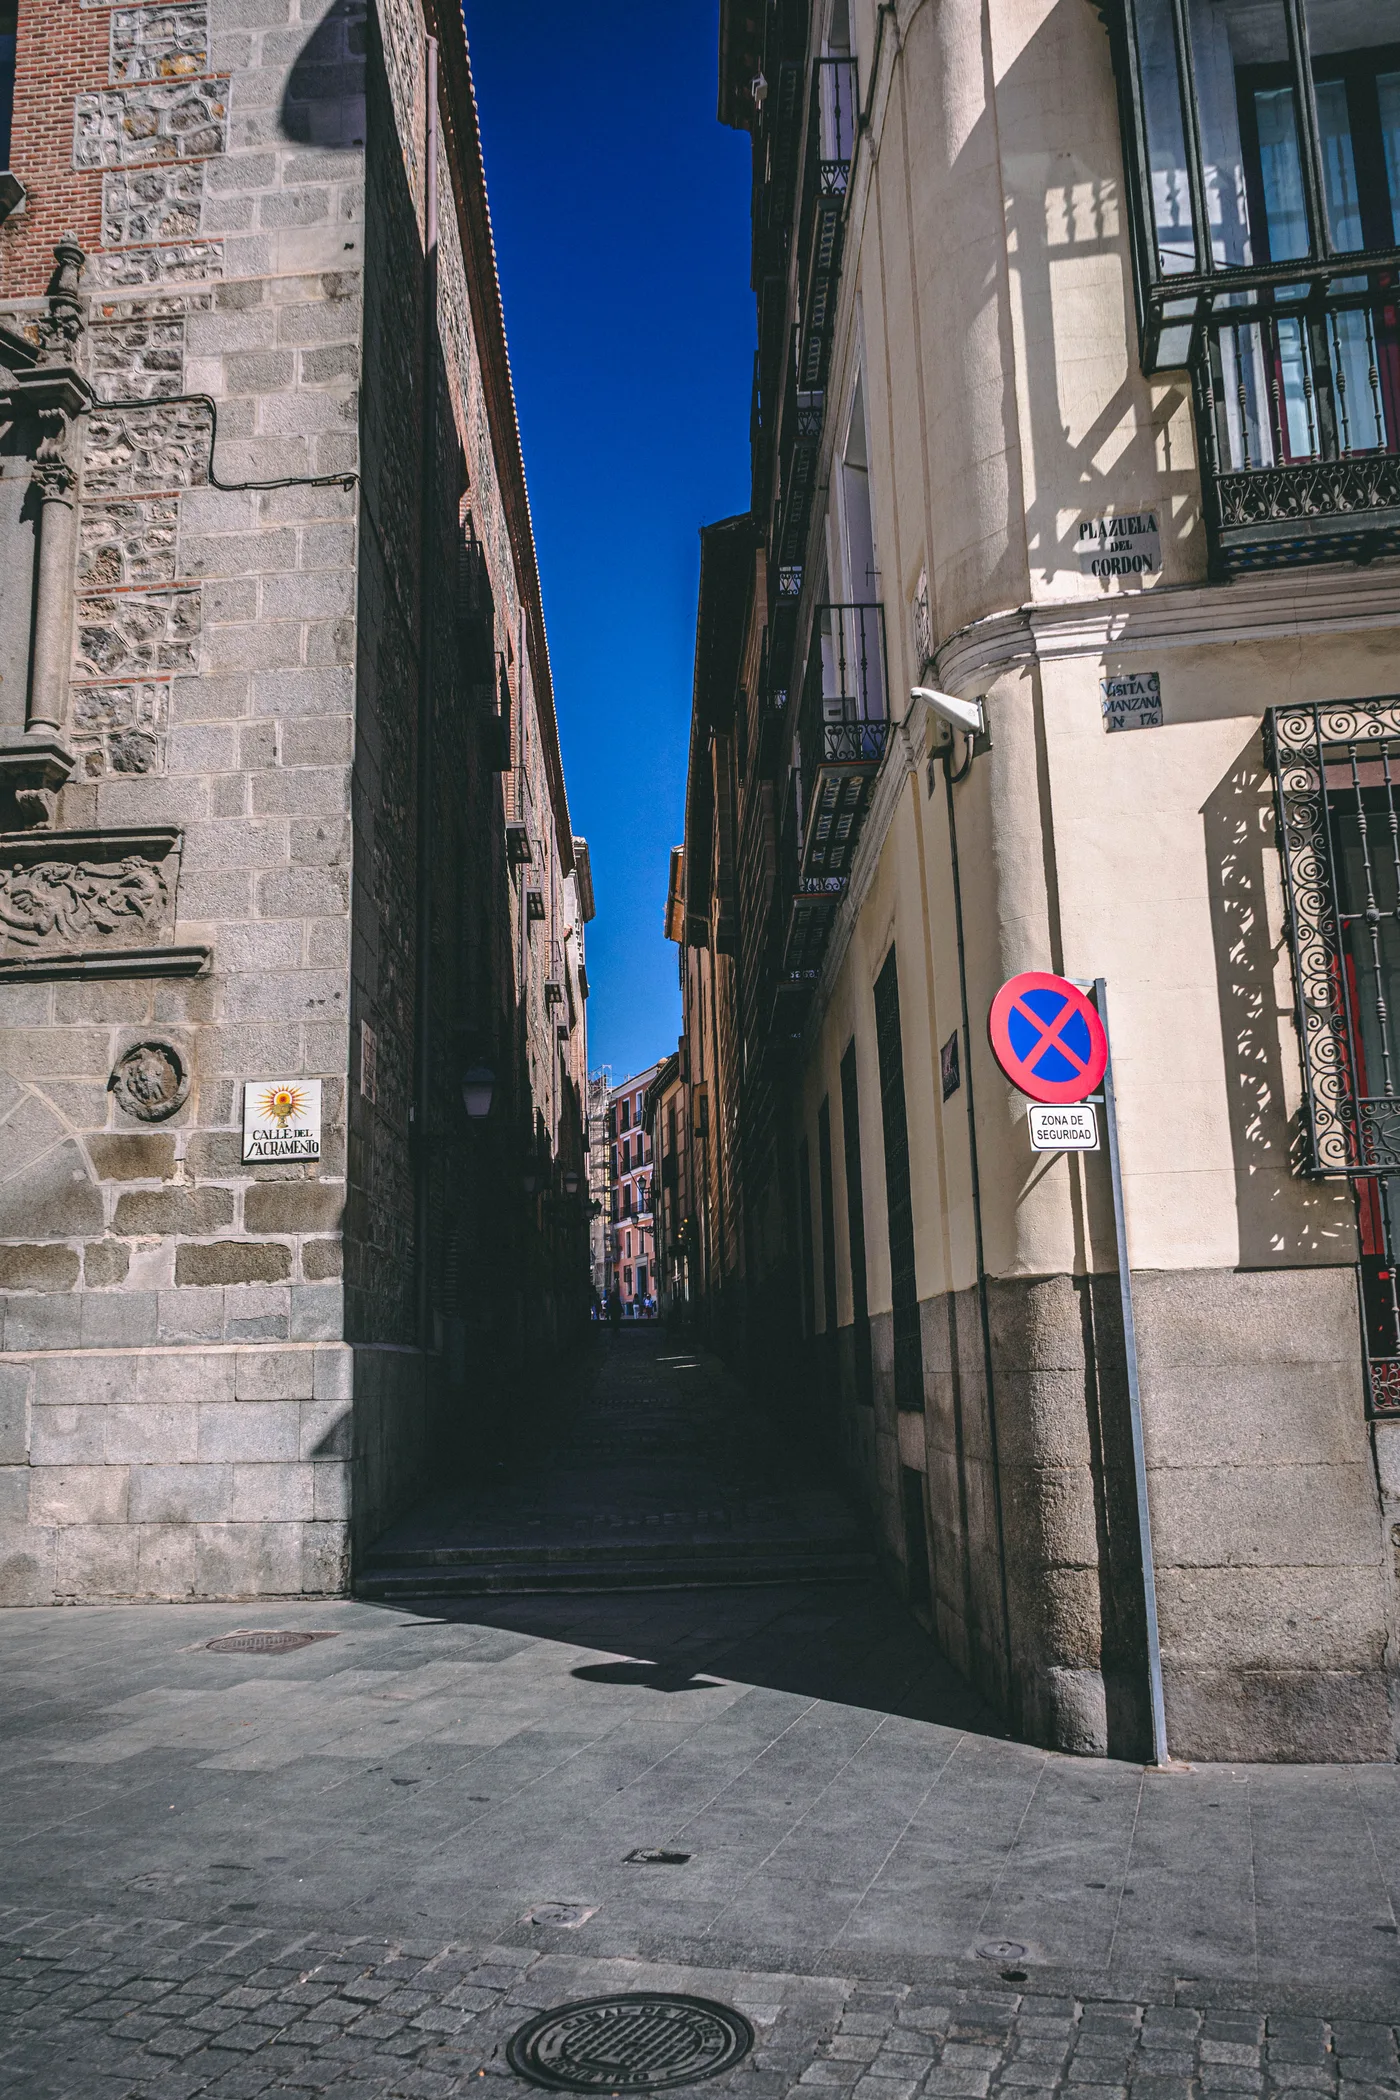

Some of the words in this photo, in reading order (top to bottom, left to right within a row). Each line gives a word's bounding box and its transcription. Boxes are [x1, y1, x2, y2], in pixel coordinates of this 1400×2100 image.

[1080, 514, 1157, 540] PLAZUELA
[1110, 540, 1132, 552] DEL
[1091, 554, 1153, 577] CORDON
[1101, 681, 1145, 697] VISITA
[1103, 696, 1161, 712] MANZANA
[1139, 711, 1158, 725] 176
[1040, 1115, 1068, 1126] ZONA
[1071, 1115, 1083, 1126] DE
[253, 1129, 292, 1140] CALLE
[294, 1129, 313, 1138] DEL
[1037, 1129, 1092, 1140] SEGURIDAD
[245, 1140, 319, 1158] SACRAMENTO
[561, 2007, 632, 2031] CANAL
[640, 2006, 672, 2017] DE
